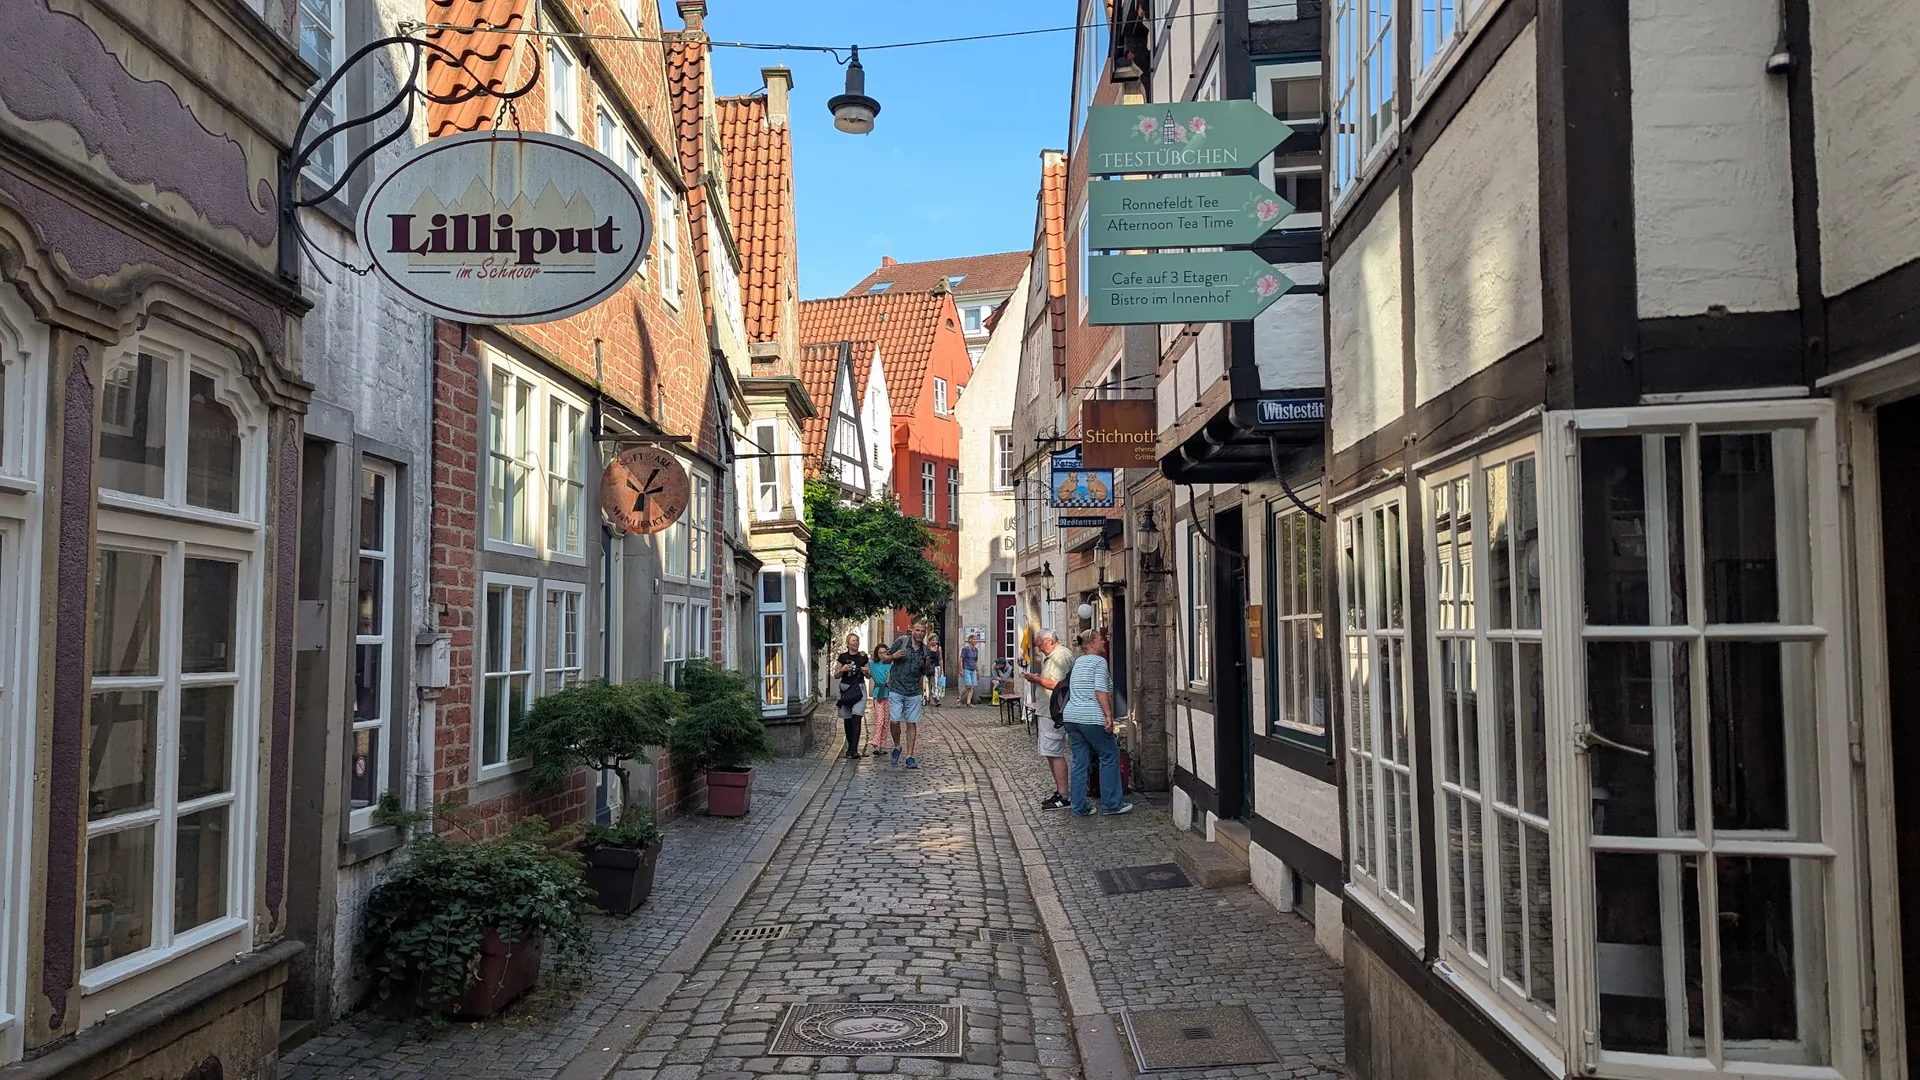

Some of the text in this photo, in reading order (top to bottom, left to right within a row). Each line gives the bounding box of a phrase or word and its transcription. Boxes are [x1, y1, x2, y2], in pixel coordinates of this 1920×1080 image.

[1099, 147, 1238, 168] TEESTÜBCHEN
[1122, 195, 1219, 211] Ronnefeldt Tee
[1107, 215, 1234, 231] Afternoon Tea Time
[386, 213, 623, 265] Lilliput
[456, 256, 541, 279] im Schnoor
[1112, 270, 1228, 287] Cafe auf 3 Etagen
[1111, 289, 1231, 306] Bistro im Innenhof
[1086, 429, 1158, 443] Stichnoth
[620, 452, 671, 469] SOFTWARE
[612, 505, 678, 528] MANUFAKTUR
[1059, 518, 1105, 526] Restaurant
